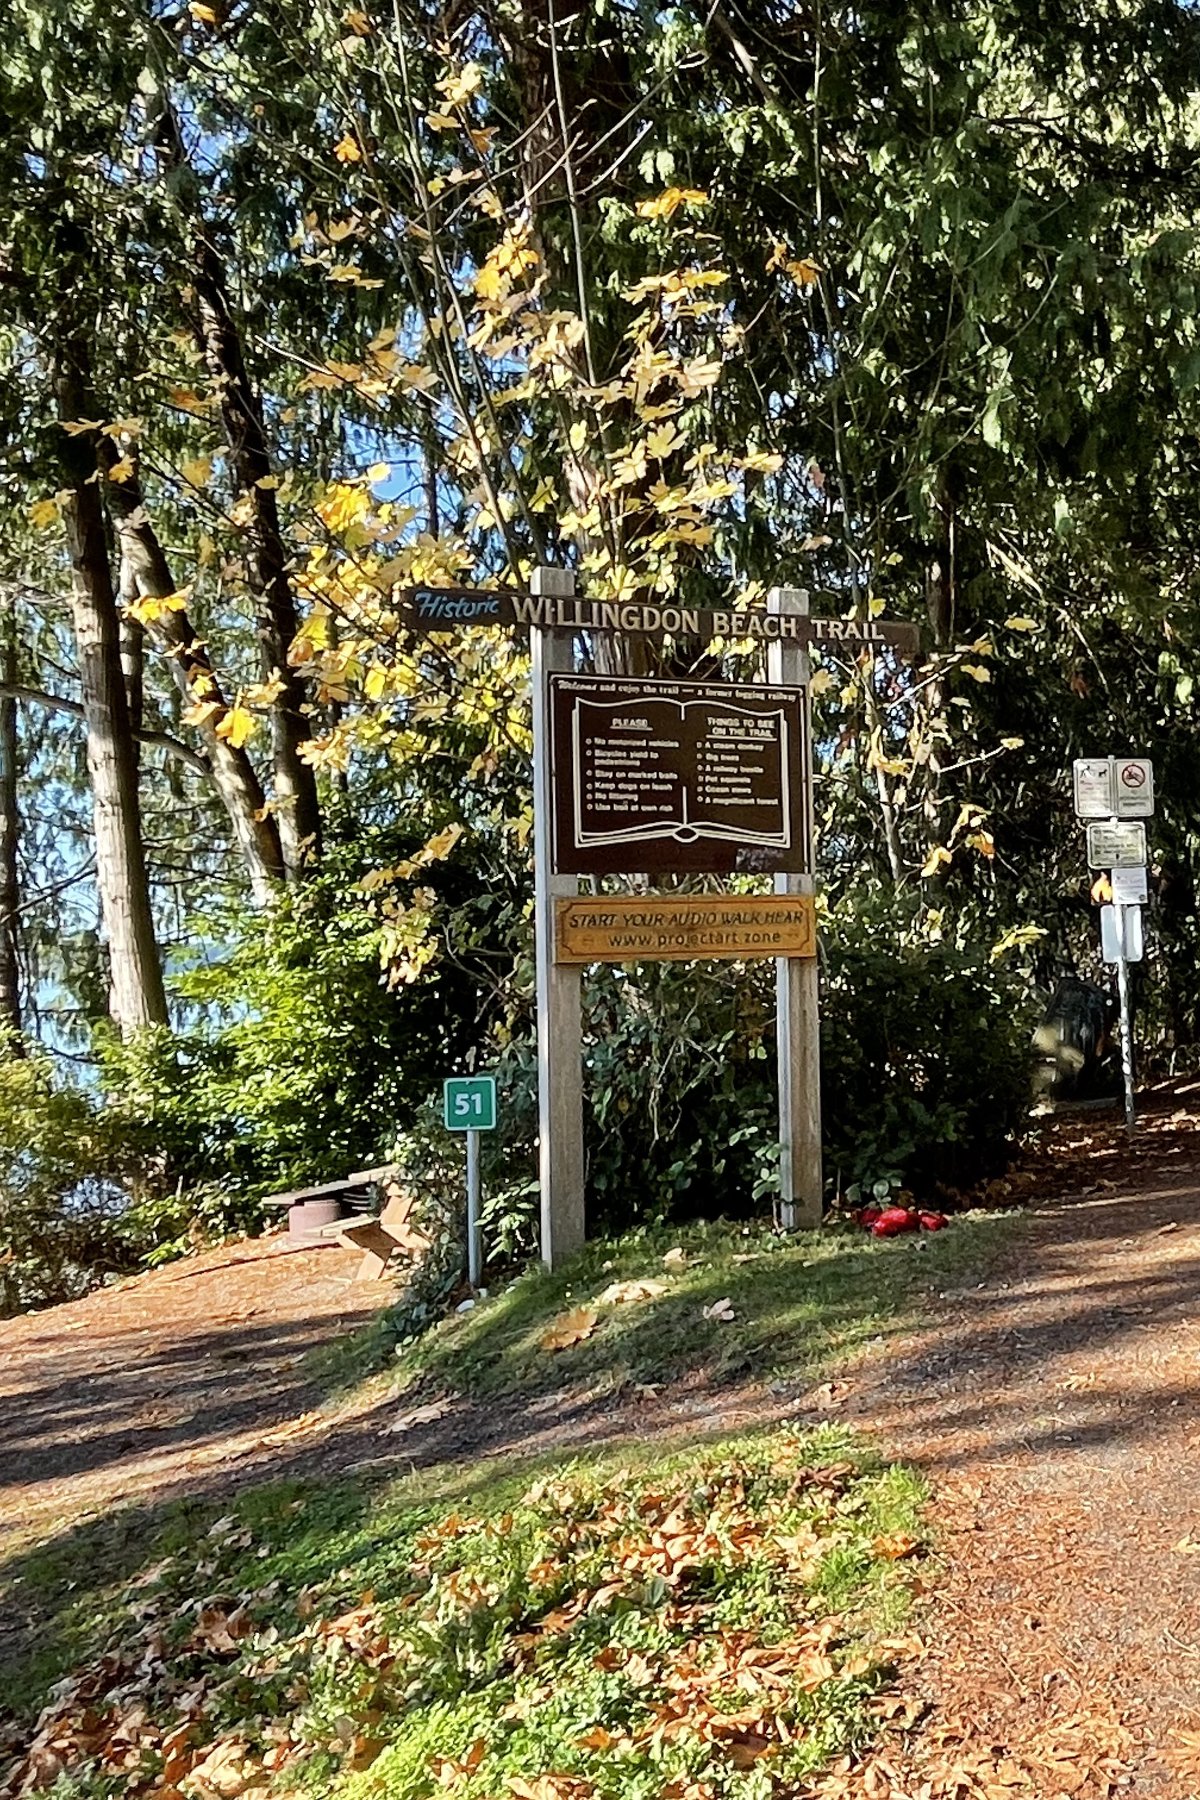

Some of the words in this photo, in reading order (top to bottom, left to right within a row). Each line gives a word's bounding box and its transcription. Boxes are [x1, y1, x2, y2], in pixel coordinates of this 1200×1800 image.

[415, 592, 499, 618] Historic
[511, 596, 699, 634] WILLINGDON
[712, 612, 797, 638] BEACH
[810, 618, 885, 640] TRAIL
[600, 683, 616, 691] and
[618, 684, 640, 693] enjoy
[643, 685, 656, 693] the
[659, 686, 679, 694] trail
[768, 692, 796, 702] railway
[612, 718, 648, 728] PLEASE
[706, 717, 740, 727] THINGS
[743, 719, 755, 728] TO
[757, 719, 775, 729] SEE
[712, 727, 726, 735] ON
[729, 728, 745, 736] THE
[750, 729, 773, 738] TRAIL
[569, 913, 617, 928] START
[623, 912, 665, 927] YOUR
[668, 910, 717, 927] AUDIO
[721, 911, 762, 926] WALK
[455, 1093, 482, 1115] 51
